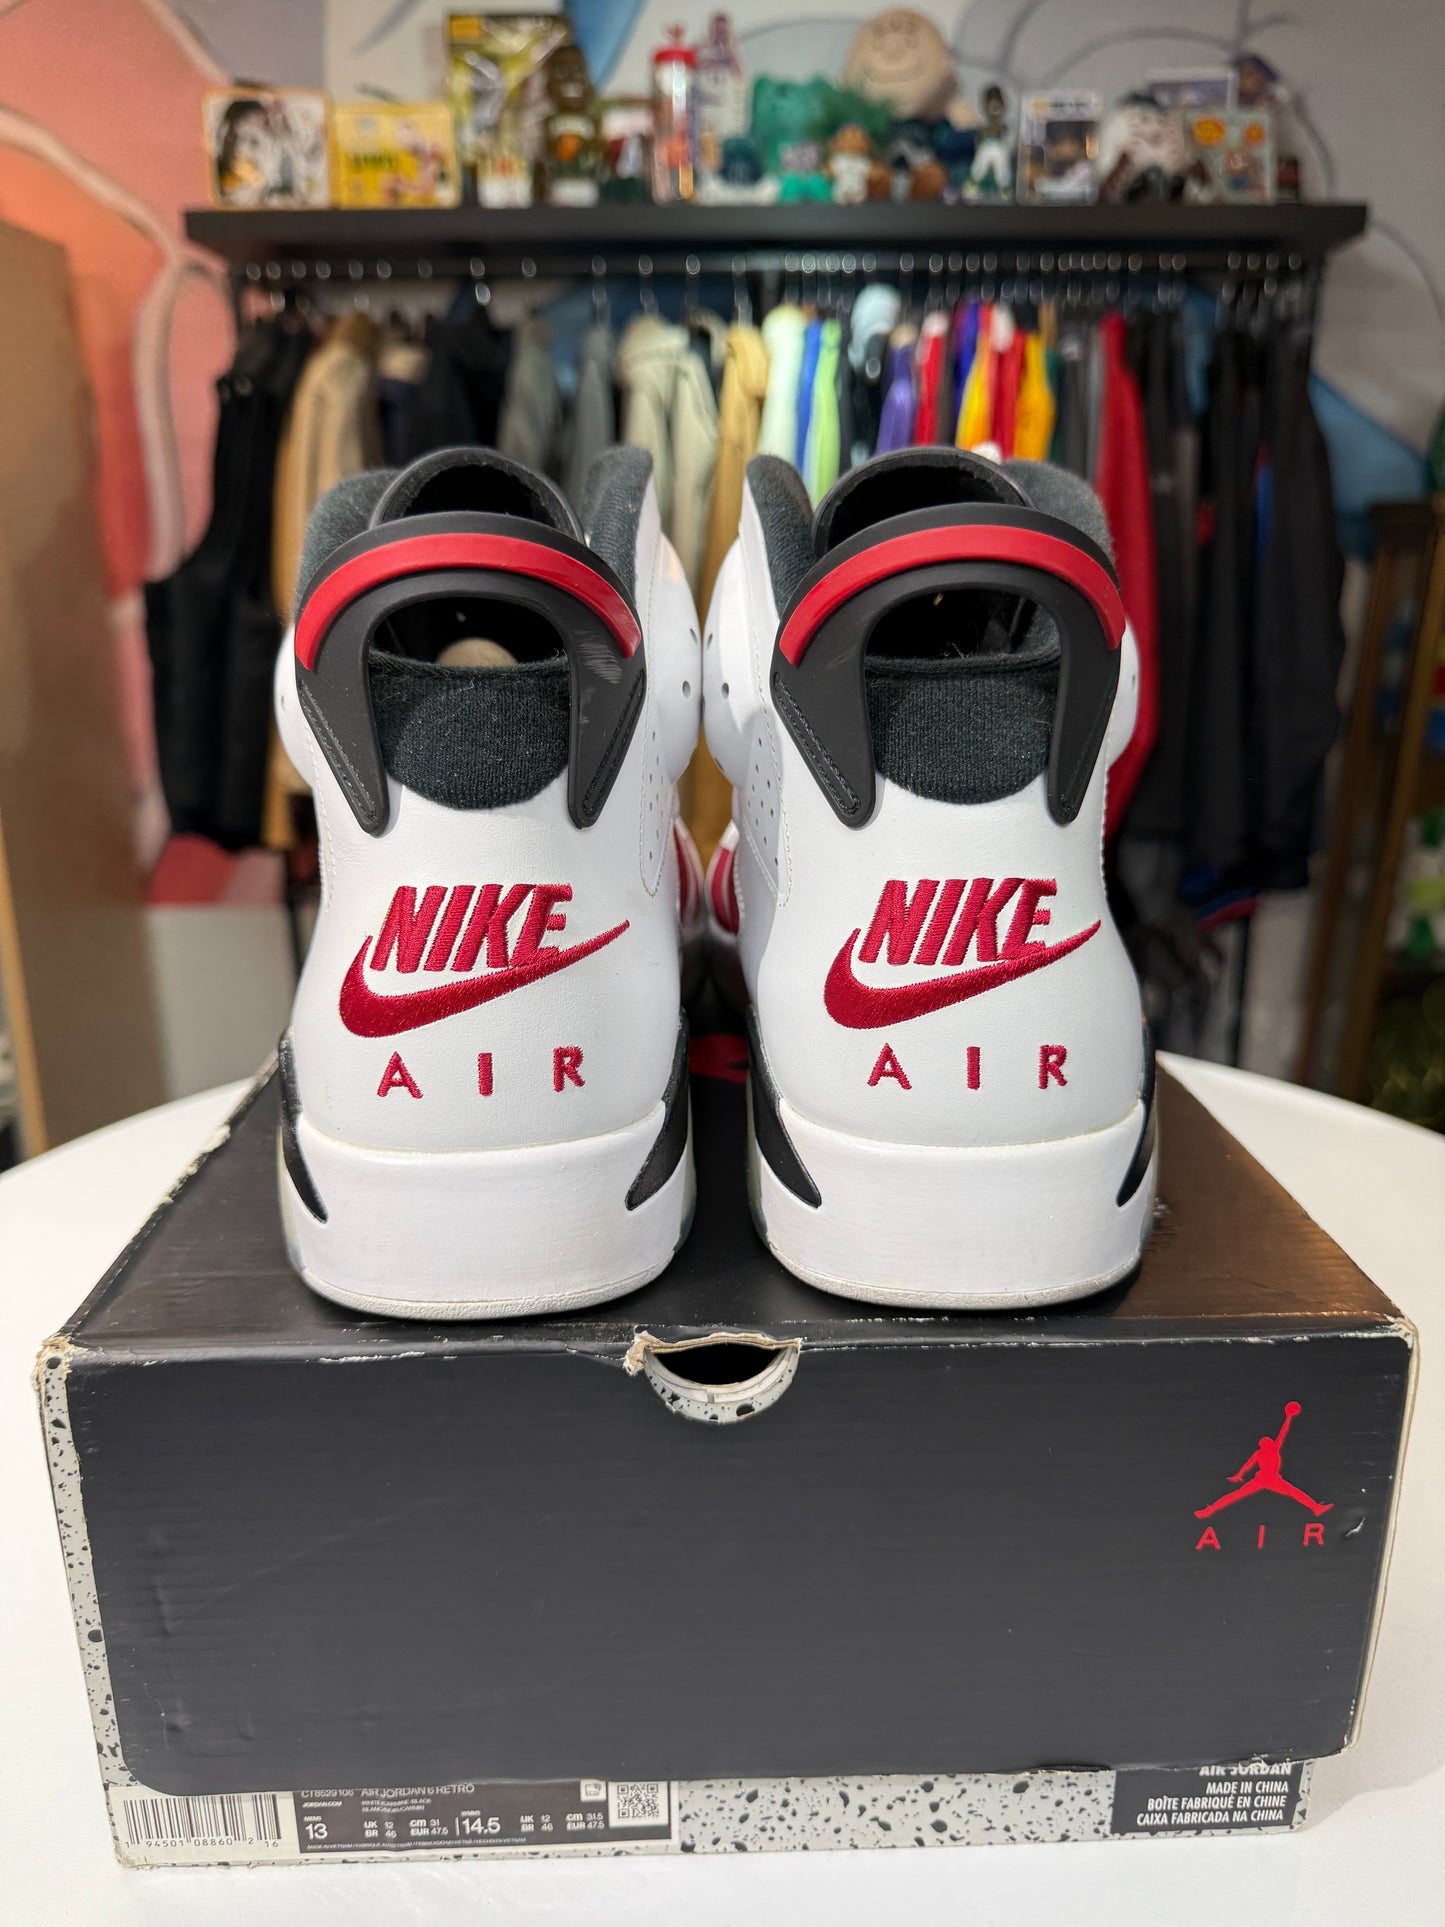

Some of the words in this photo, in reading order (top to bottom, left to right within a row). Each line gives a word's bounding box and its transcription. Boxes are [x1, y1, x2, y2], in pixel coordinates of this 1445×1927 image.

[370, 883, 574, 974] NIKE
[858, 877, 1059, 966] NIKE
[377, 1044, 585, 1099] AIR
[867, 1043, 1068, 1091] AIR
[1195, 1522, 1325, 1551] AIR
[1205, 1782, 1239, 1795] MADE
[1240, 1781, 1253, 1793] IN
[1255, 1780, 1289, 1794] CHINA
[1236, 1795, 1251, 1808] EN
[1253, 1794, 1287, 1808] CHINE
[409, 1819, 427, 1828] cm
[520, 1815, 534, 1823] UK
[565, 1813, 583, 1822] cm
[1136, 1812, 1168, 1826] CAIXA
[1170, 1810, 1230, 1825] FABRICADA
[1232, 1810, 1248, 1822] NA
[1250, 1808, 1283, 1821] CHINA
[305, 1822, 328, 1840] 13
[363, 1820, 378, 1829] UK
[384, 1821, 394, 1830] 12
[410, 1827, 430, 1836] EUR
[462, 1816, 501, 1836] 14.5
[520, 1823, 534, 1833] BR
[566, 1821, 585, 1831] EUR
[364, 1829, 379, 1838] BR
[146, 1839, 185, 1848] 94501
[193, 1837, 233, 1846] 08860
